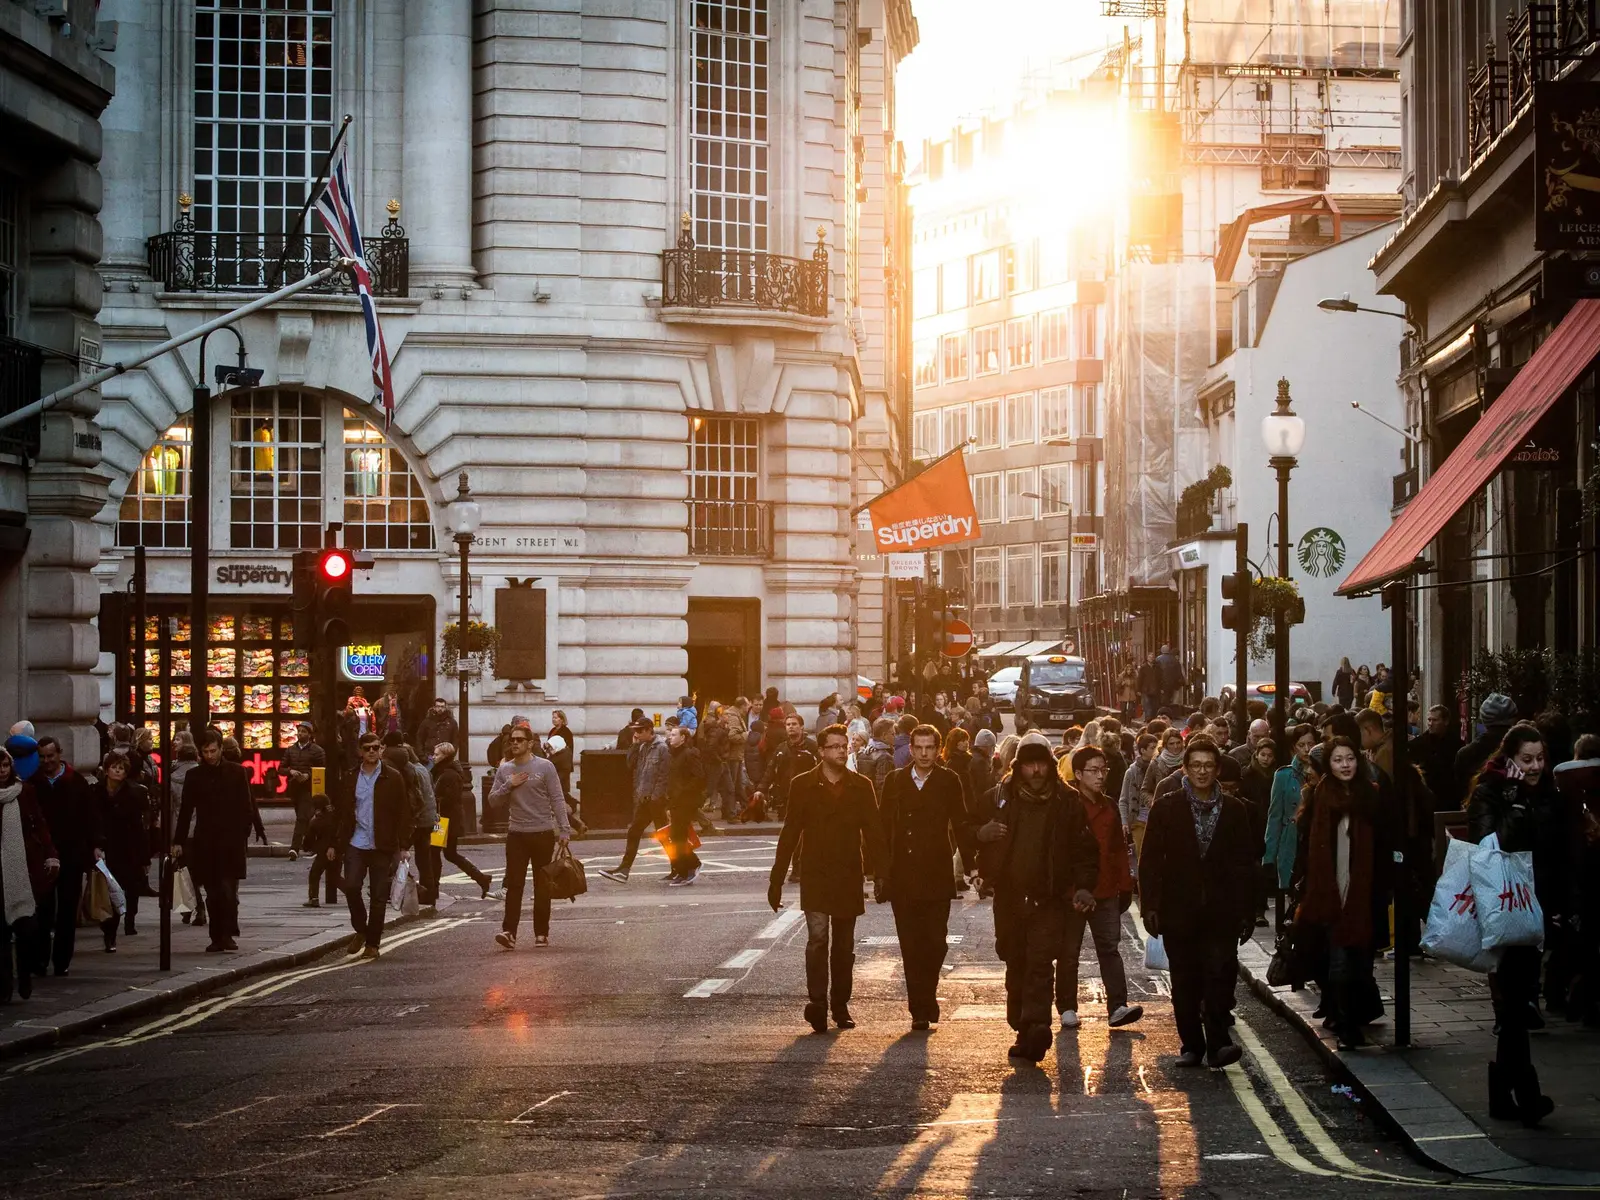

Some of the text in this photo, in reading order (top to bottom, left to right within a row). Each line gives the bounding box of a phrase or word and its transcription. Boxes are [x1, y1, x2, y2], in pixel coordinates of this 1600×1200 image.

[877, 514, 973, 546] Superdry
[470, 537, 507, 547] EGENT
[516, 537, 557, 547] STREET
[216, 566, 293, 587] Superdry
[348, 645, 382, 656] T-SHIRT
[1498, 880, 1534, 913] H&M
